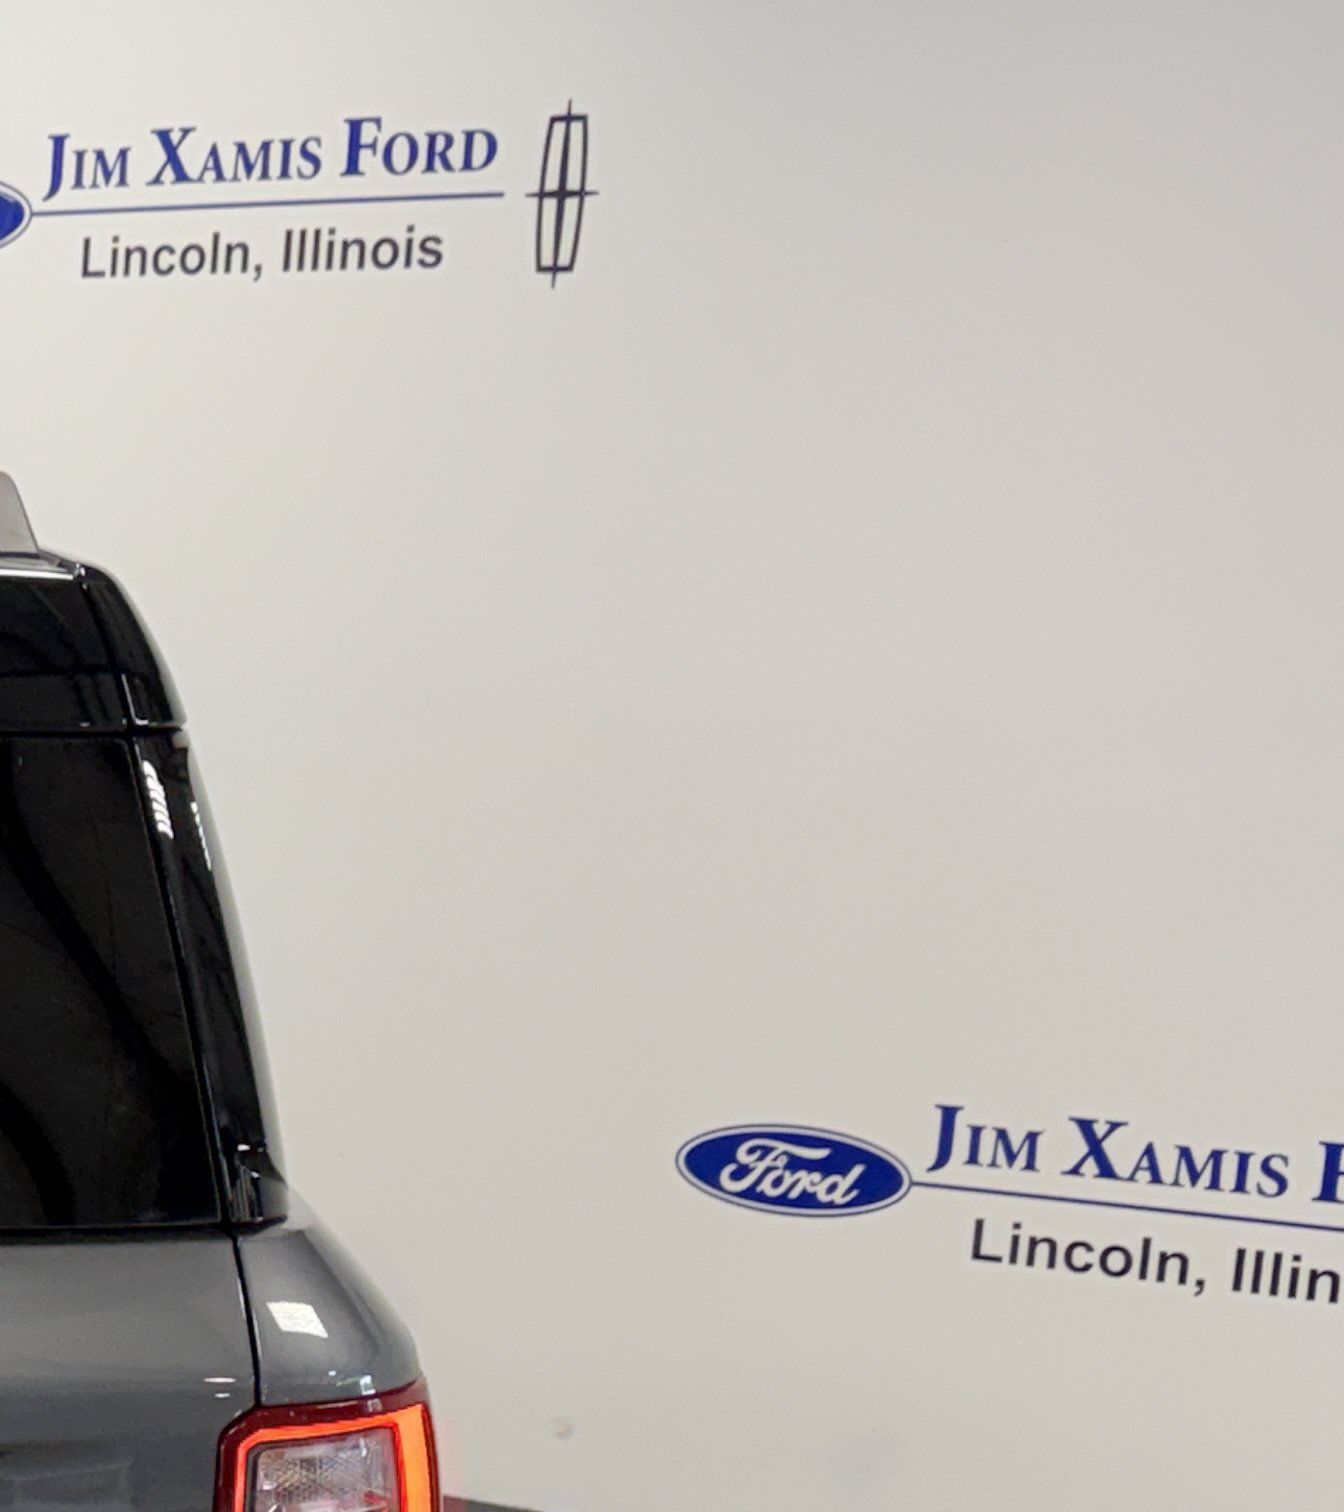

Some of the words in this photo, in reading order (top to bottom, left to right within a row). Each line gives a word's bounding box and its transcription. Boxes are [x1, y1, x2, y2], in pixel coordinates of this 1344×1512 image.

[41, 132, 132, 202] JIM
[145, 126, 323, 187] XAMIS
[339, 116, 499, 178] FORD
[80, 230, 263, 283] Lincoln,
[281, 223, 444, 273] Illinois
[718, 1136, 865, 1207] Ford
[925, 1103, 1043, 1174] JIM
[1060, 1116, 1290, 1199] XAMIS
[970, 1218, 1207, 1298] Lincoln,
[1230, 1246, 1343, 1305] Illin
